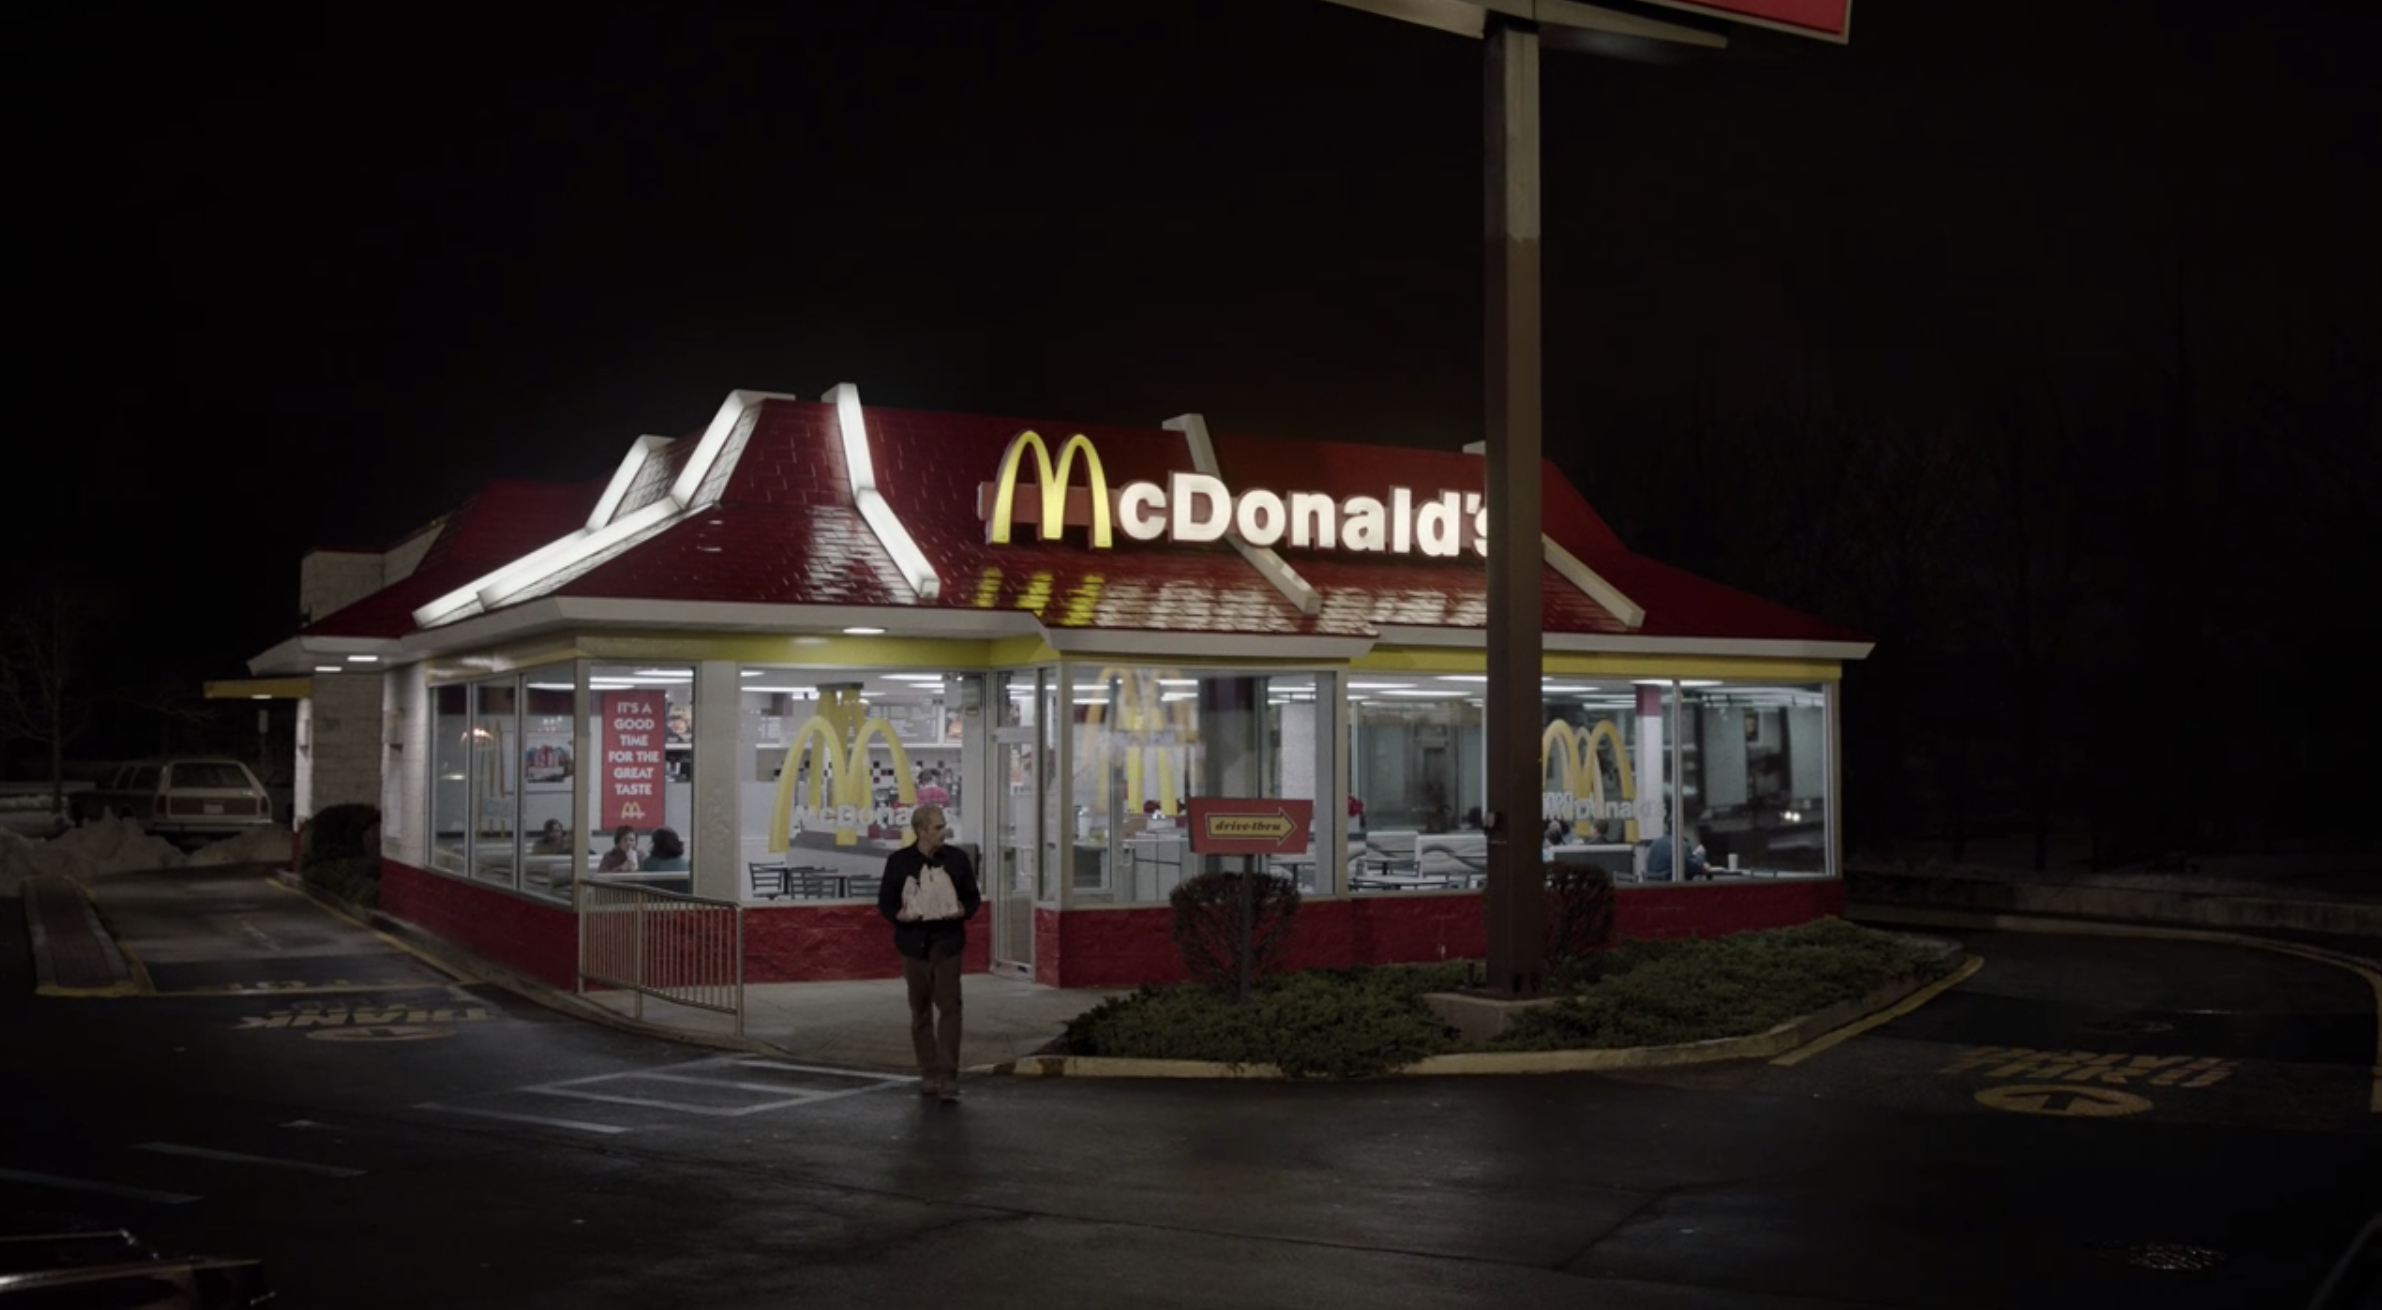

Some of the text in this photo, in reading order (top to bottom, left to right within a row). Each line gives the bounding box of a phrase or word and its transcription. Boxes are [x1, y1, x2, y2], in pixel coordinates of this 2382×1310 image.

[617, 702, 652, 714] IT'S A
[614, 718, 655, 730] GOOD
[619, 734, 648, 746] TIME
[608, 751, 660, 763] FOR THE
[613, 767, 654, 779] GREAT
[614, 783, 652, 795] TASTE
[1214, 820, 1282, 832] drive-thru
